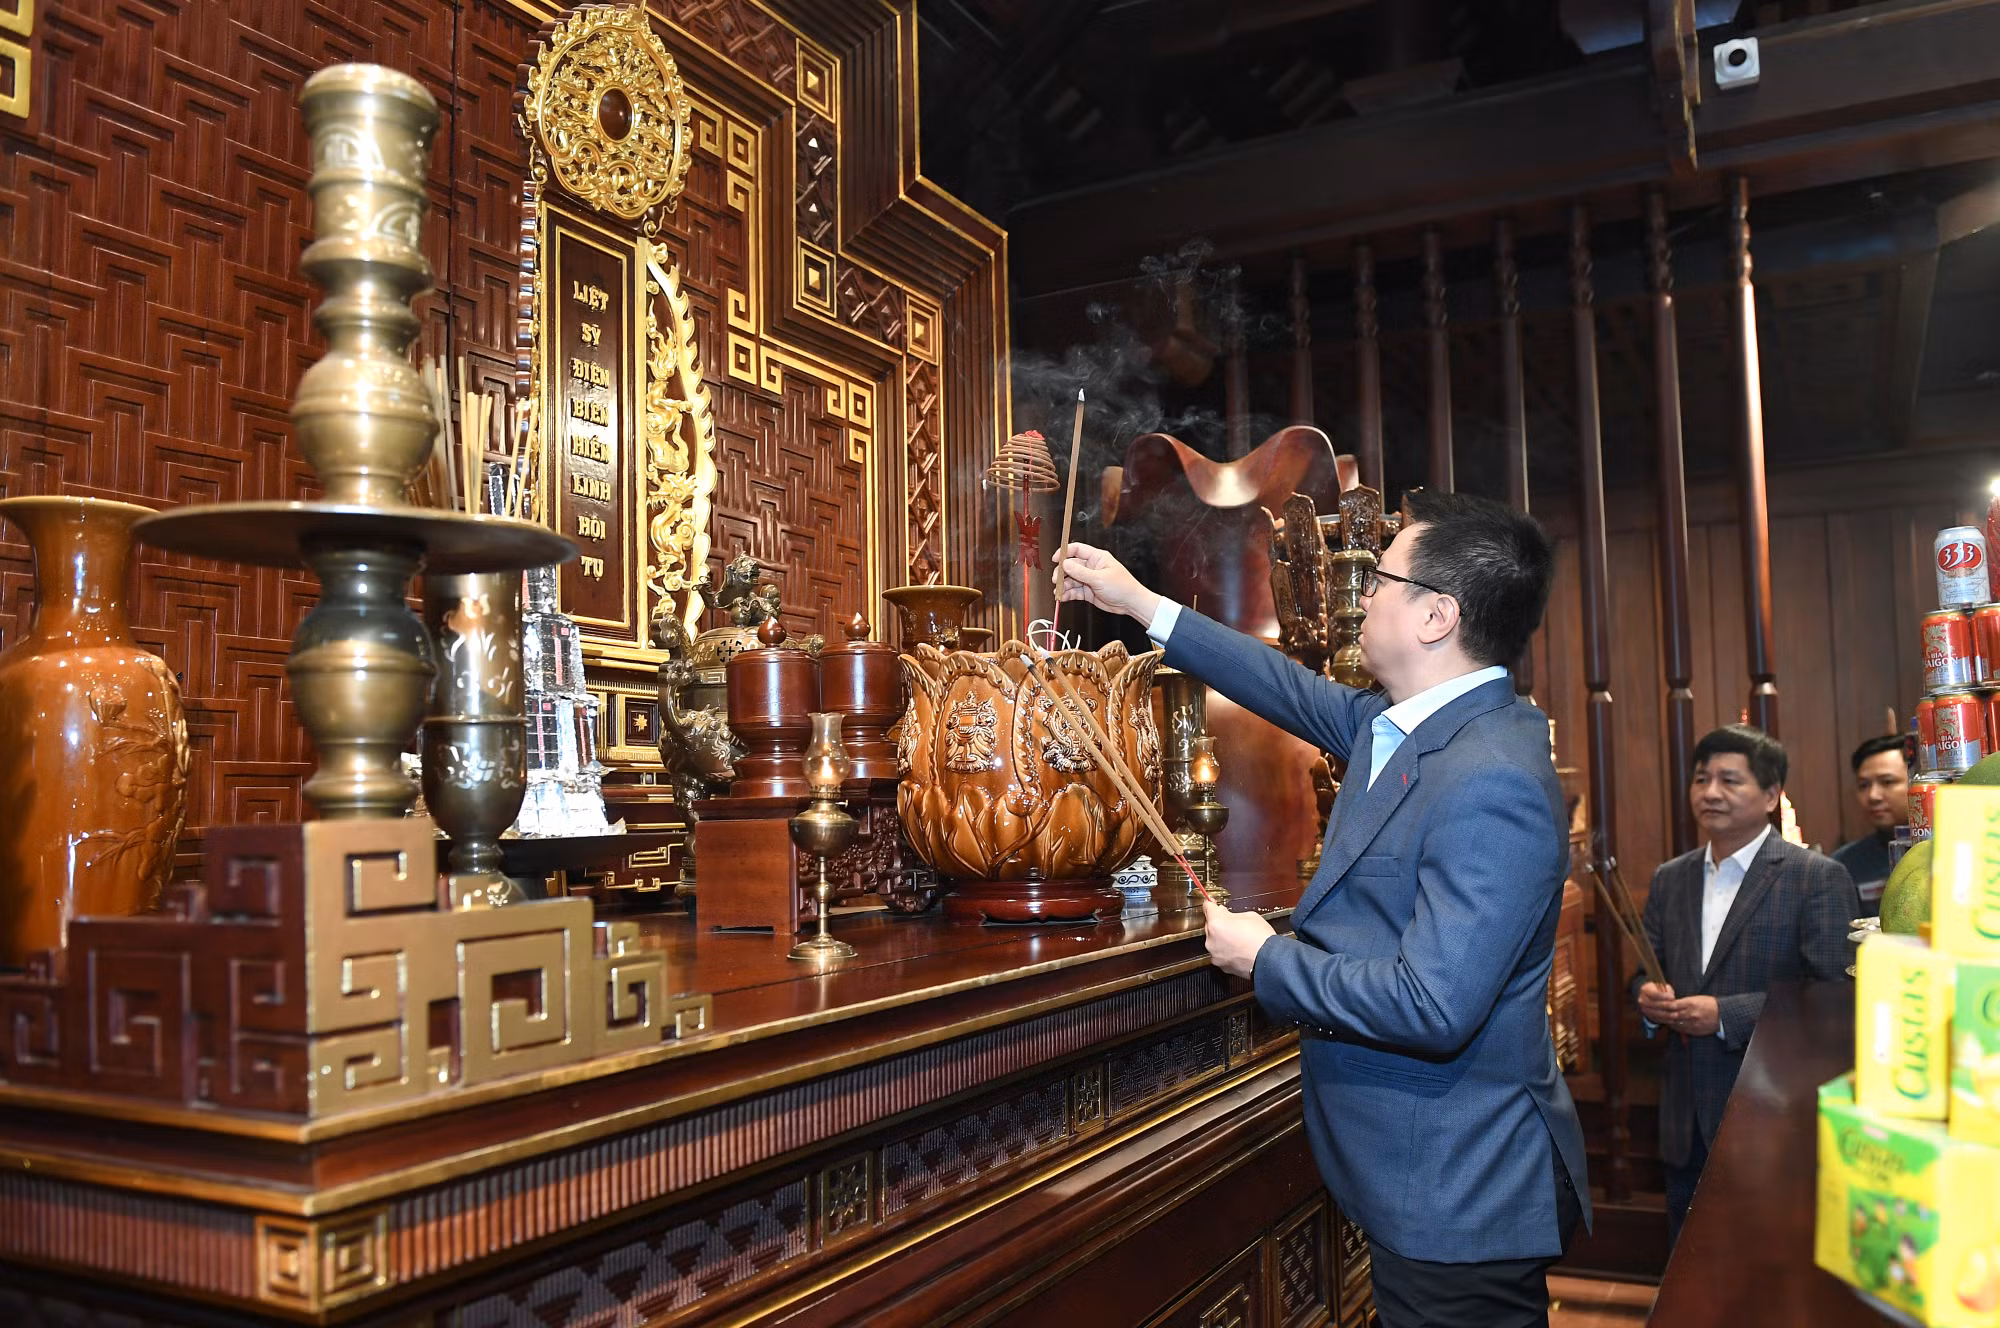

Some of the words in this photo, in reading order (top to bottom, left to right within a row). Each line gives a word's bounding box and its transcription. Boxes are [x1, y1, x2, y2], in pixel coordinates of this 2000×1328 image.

[573, 280, 609, 311] LIỆT
[573, 399, 609, 426] BIÊN
[572, 473, 611, 501] LINH
[578, 515, 606, 542] HỘI
[581, 555, 604, 581] TỤ
[1942, 540, 1975, 569] 333
